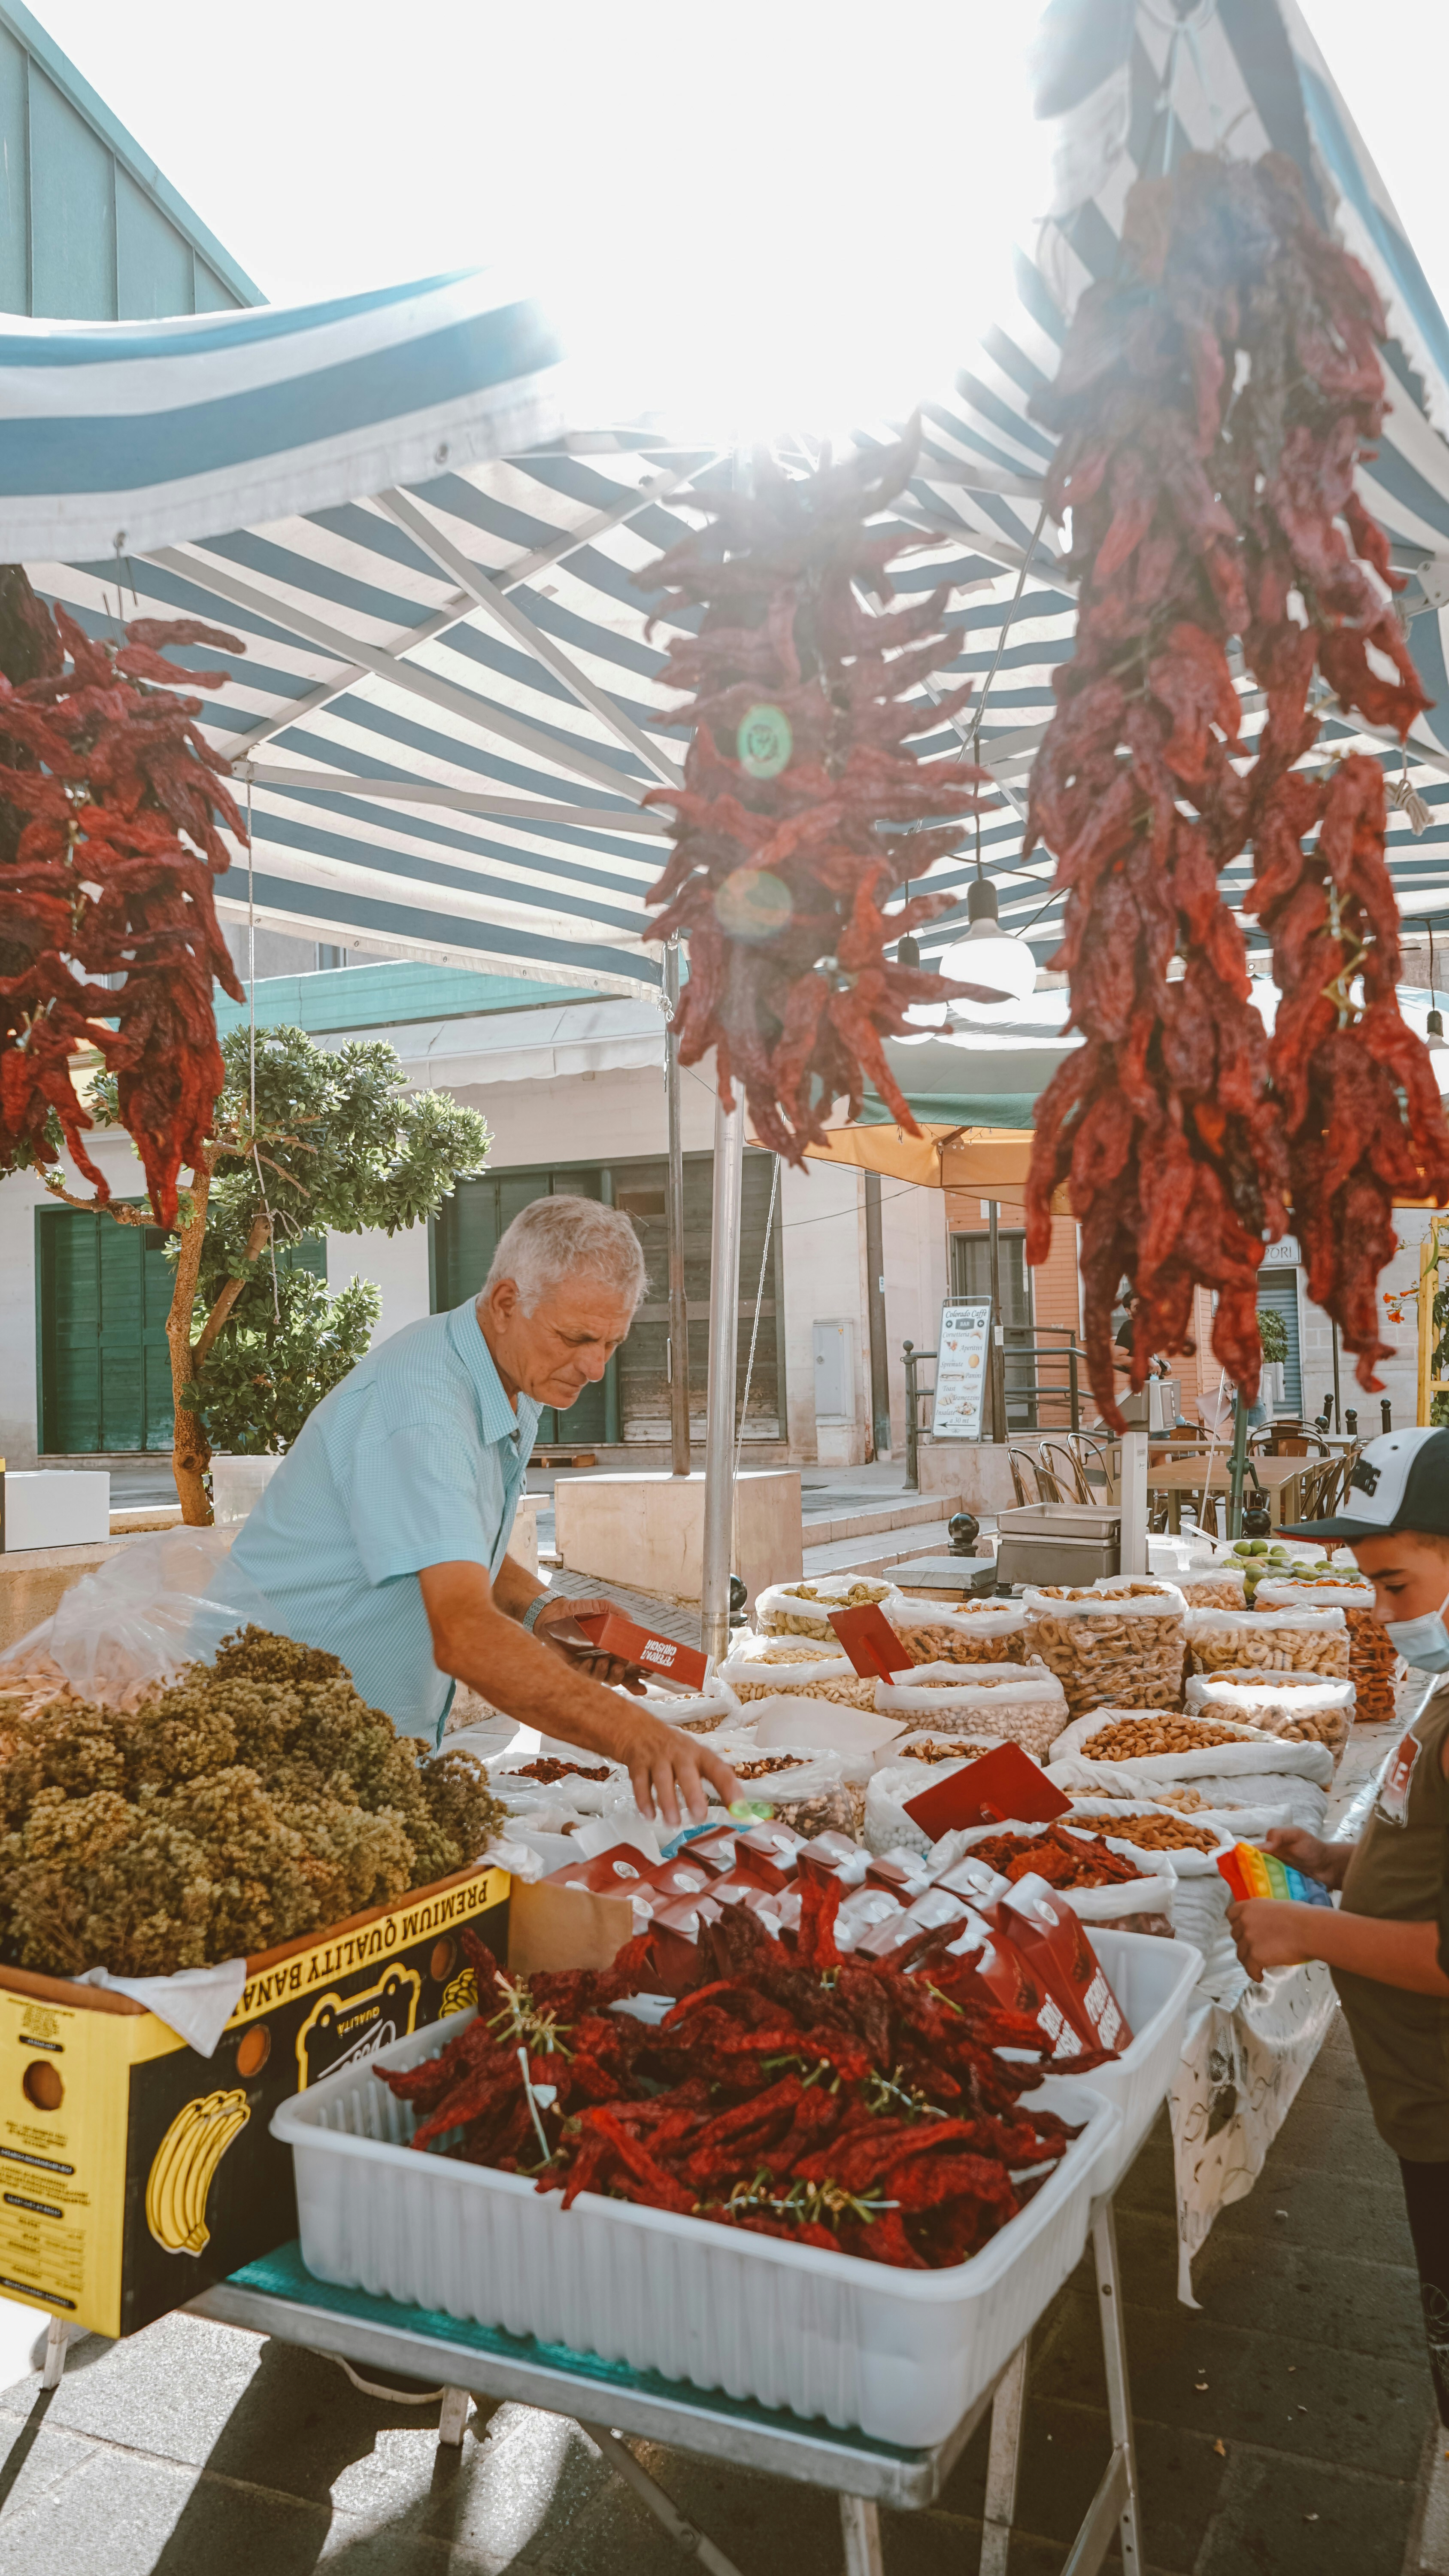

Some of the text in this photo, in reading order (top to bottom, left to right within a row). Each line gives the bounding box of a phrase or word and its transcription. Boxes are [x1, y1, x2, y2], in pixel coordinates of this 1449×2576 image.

[946, 1309, 970, 1318] Colorado
[640, 1649, 675, 1667] PEPERONI
[232, 1880, 488, 2017] PREMIUM QUALITY BANA
